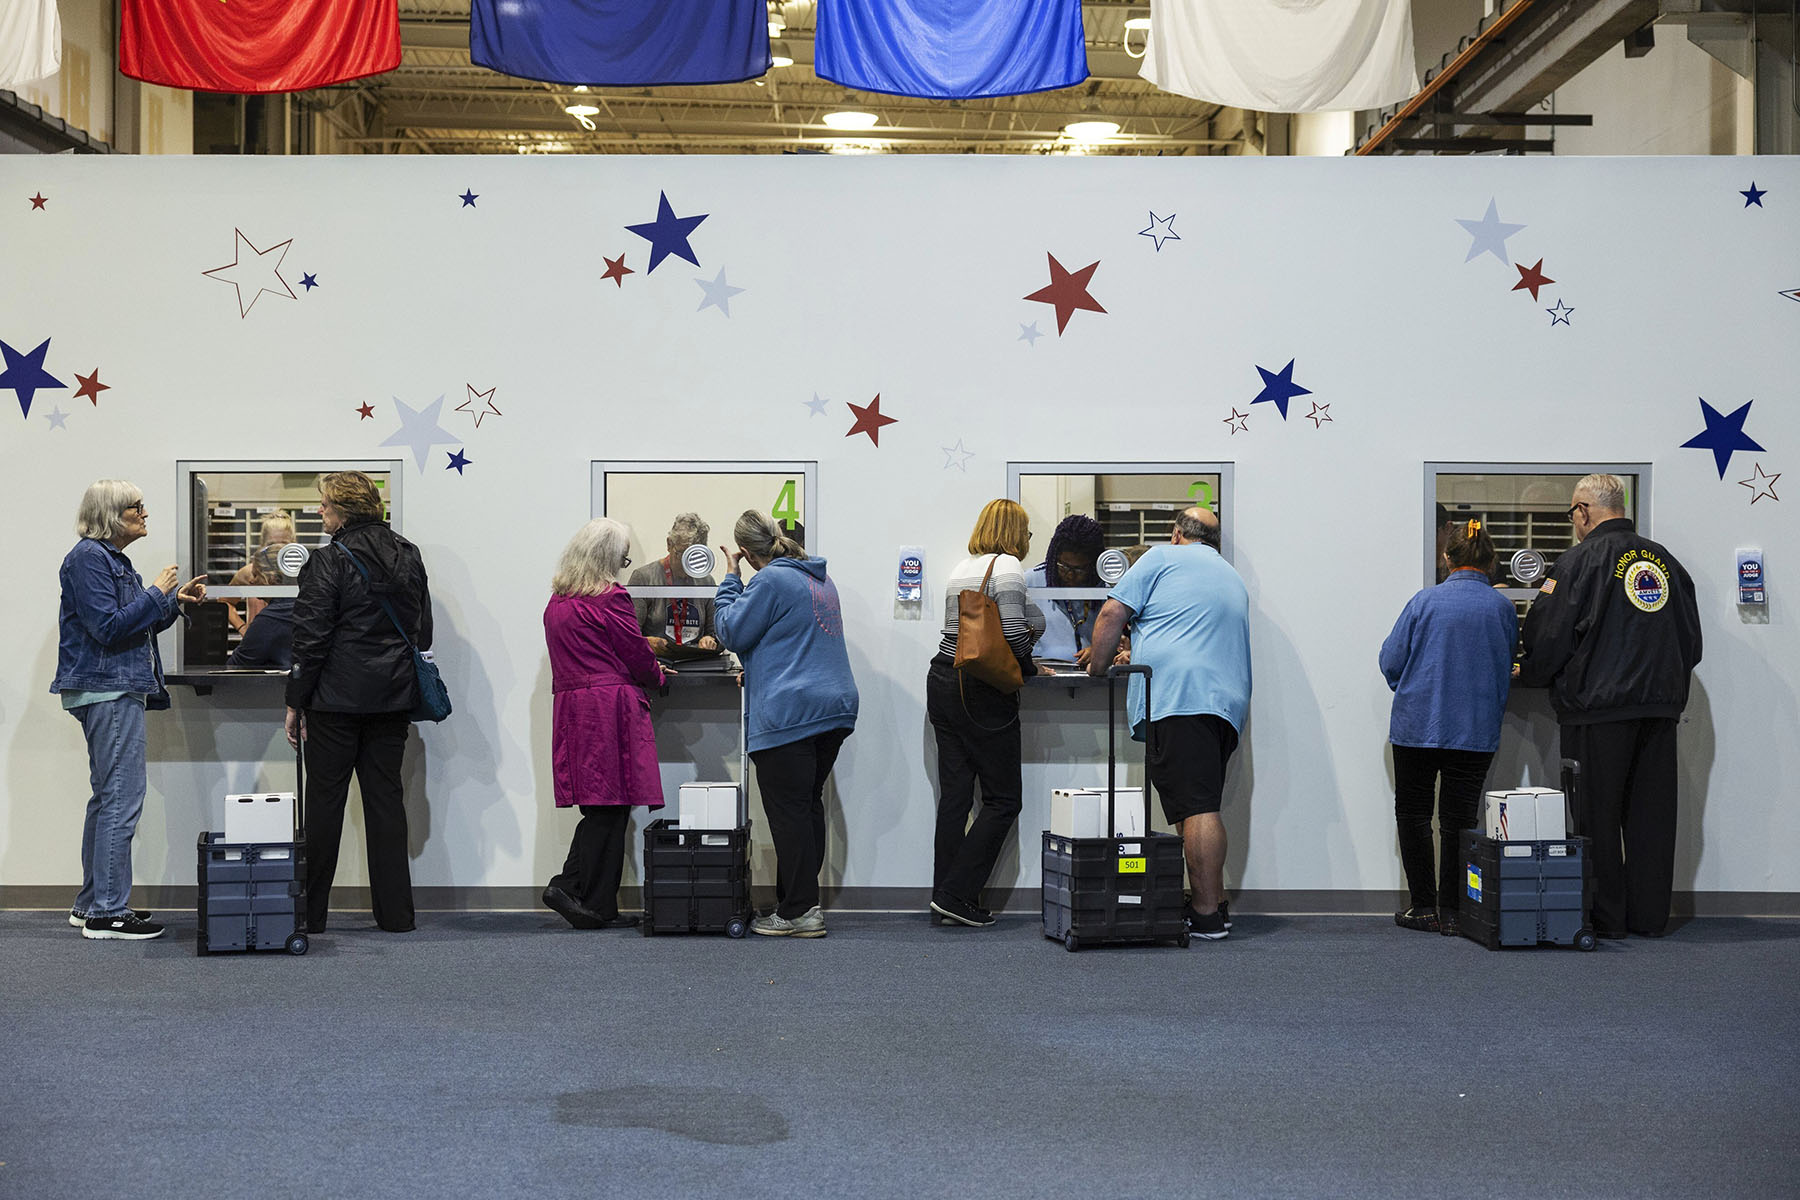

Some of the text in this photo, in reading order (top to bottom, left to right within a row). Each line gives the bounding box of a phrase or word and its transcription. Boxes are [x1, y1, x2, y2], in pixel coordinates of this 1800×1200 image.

[772, 480, 799, 530] 4
[1614, 549, 1670, 579] HONOR GUARD
